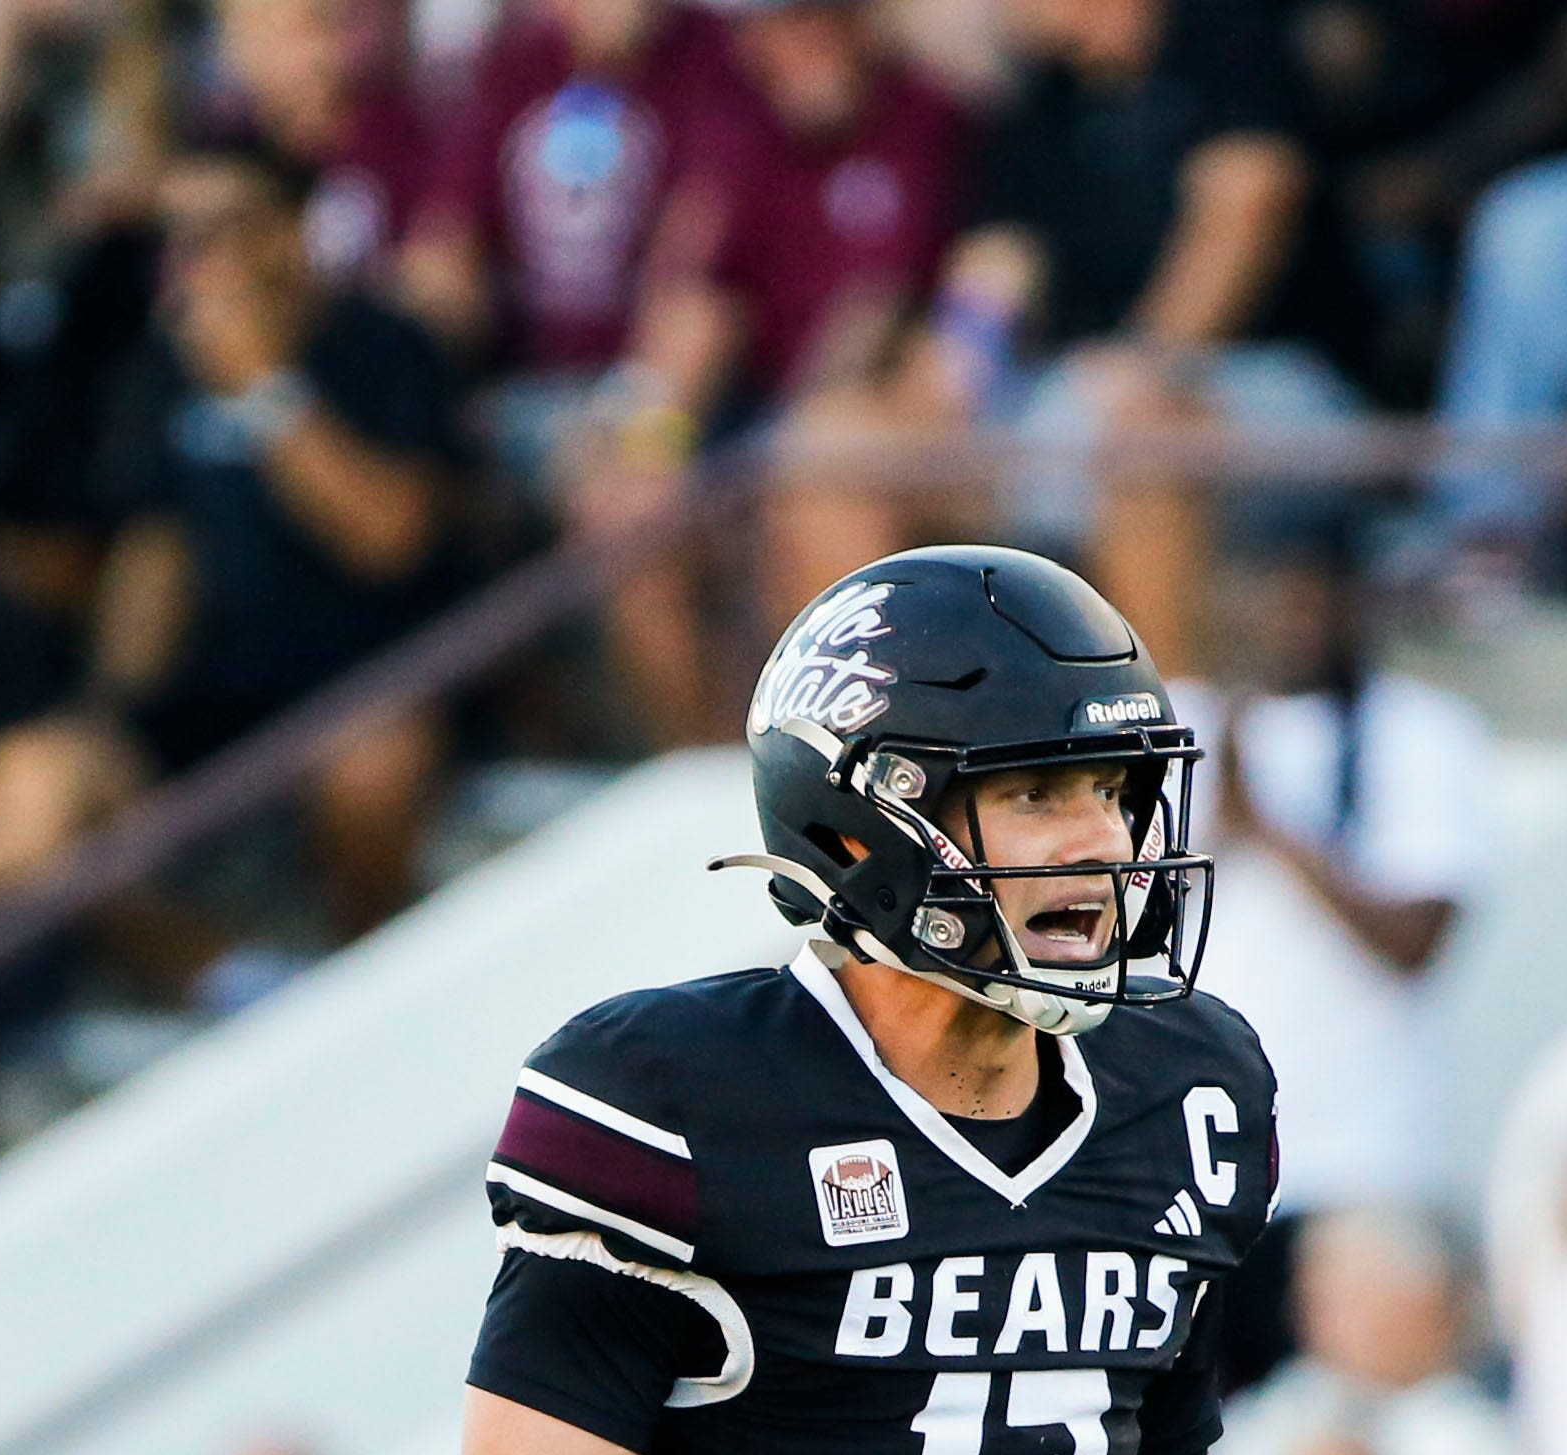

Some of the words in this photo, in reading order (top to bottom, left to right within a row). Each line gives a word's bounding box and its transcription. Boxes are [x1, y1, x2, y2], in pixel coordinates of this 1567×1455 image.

[751, 644, 894, 735] State
[1085, 698, 1162, 724] Riddell
[1074, 975, 1111, 993] Riddell
[1182, 1086, 1240, 1207] C
[821, 1170, 897, 1219] VALLEY
[834, 1252, 1188, 1358] BEARS
